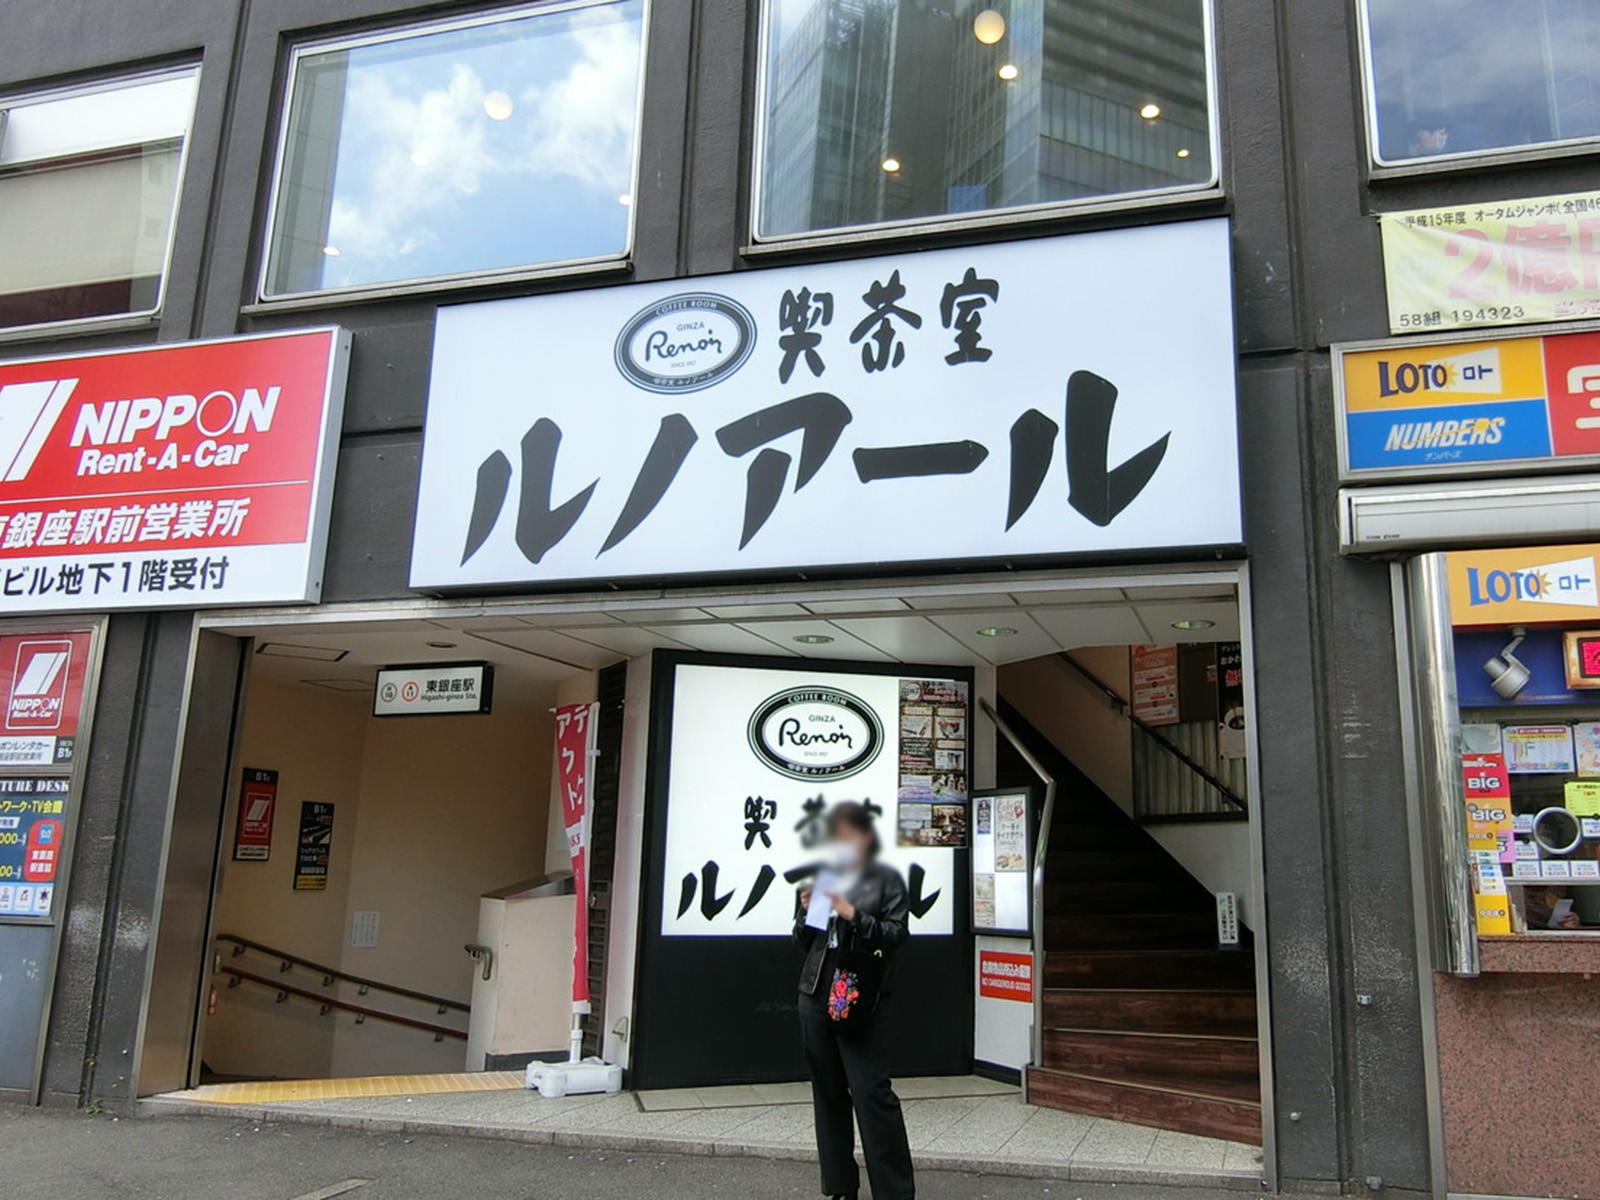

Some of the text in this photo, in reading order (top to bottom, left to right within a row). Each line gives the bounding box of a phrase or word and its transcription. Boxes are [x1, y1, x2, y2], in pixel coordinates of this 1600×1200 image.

[1405, 211, 1467, 228] 平成15年度
[655, 300, 717, 316] COFFEE ROOM
[1400, 306, 1525, 328] 58組 194323
[677, 321, 704, 331] GINZA
[779, 267, 999, 384] 喫茶室
[1378, 361, 1448, 398] LOTO
[69, 386, 281, 447] NIPPON
[1384, 417, 1505, 452] NUMBERS
[77, 440, 249, 476] Rent-A-Car
[460, 370, 1172, 565] ルノアール
[0, 497, 251, 549] 銀座駅前営業所
[3, 556, 230, 596] ビル地下1階受付
[1466, 567, 1541, 606] LOTO
[426, 678, 474, 693] 東銀座駅
[788, 693, 848, 705] COFFEE ROOM
[11, 698, 60, 710] NIPPON
[808, 714, 836, 722] GINZA
[1468, 777, 1501, 789] BIG
[1471, 809, 1506, 821] BIG
[676, 860, 941, 921] ルノル
